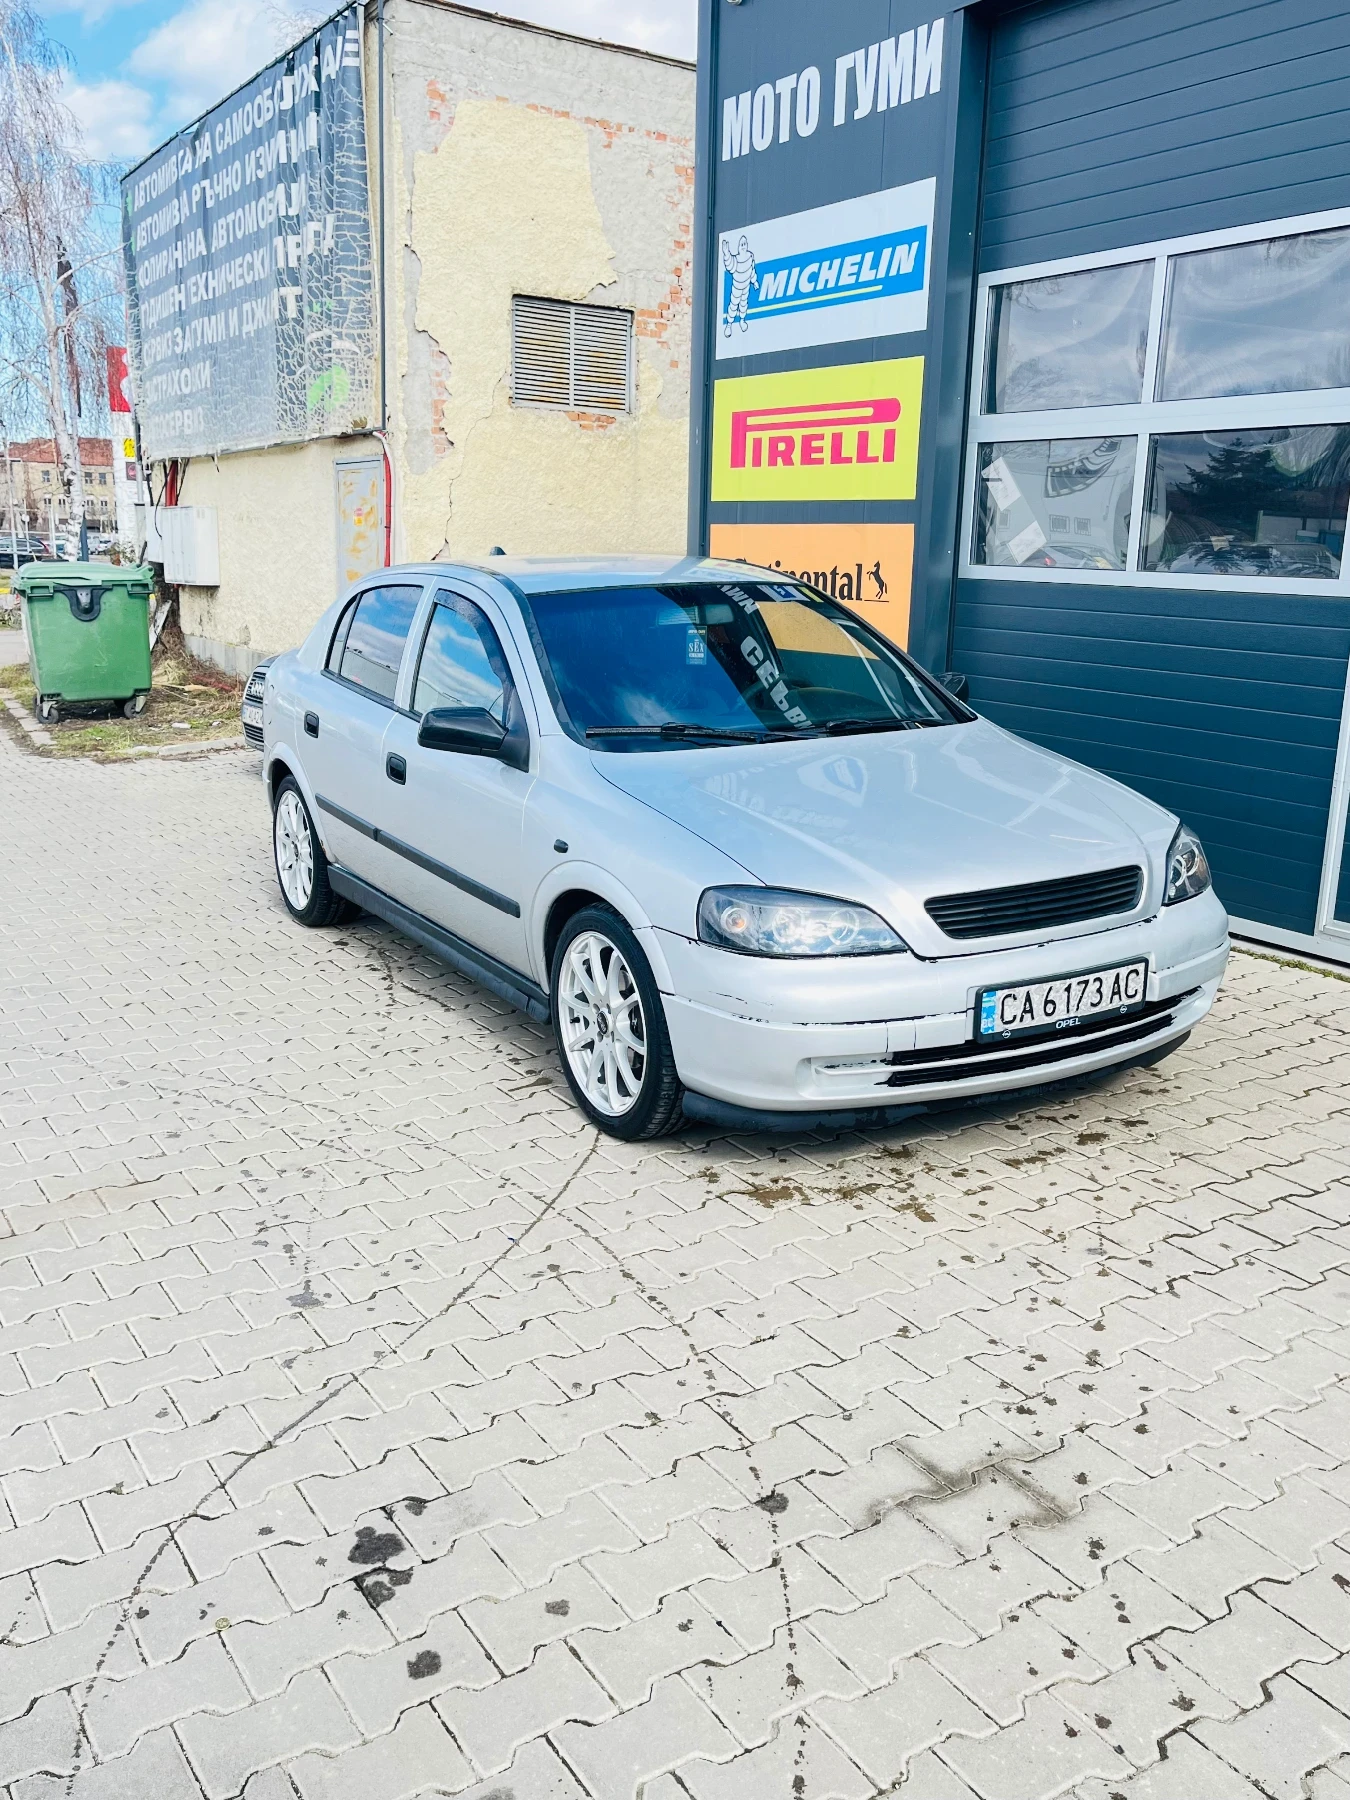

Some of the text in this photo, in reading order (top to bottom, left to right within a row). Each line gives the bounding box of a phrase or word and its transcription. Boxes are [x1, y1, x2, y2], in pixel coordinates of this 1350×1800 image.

[722, 18, 944, 162] МОТО ГУМИ
[192, 160, 241, 213] РЪЧНО
[758, 241, 919, 301] MICHELIN
[229, 307, 239, 337] И
[730, 398, 901, 468] PIRELLI
[1056, 1017, 1081, 1029] OPEL
